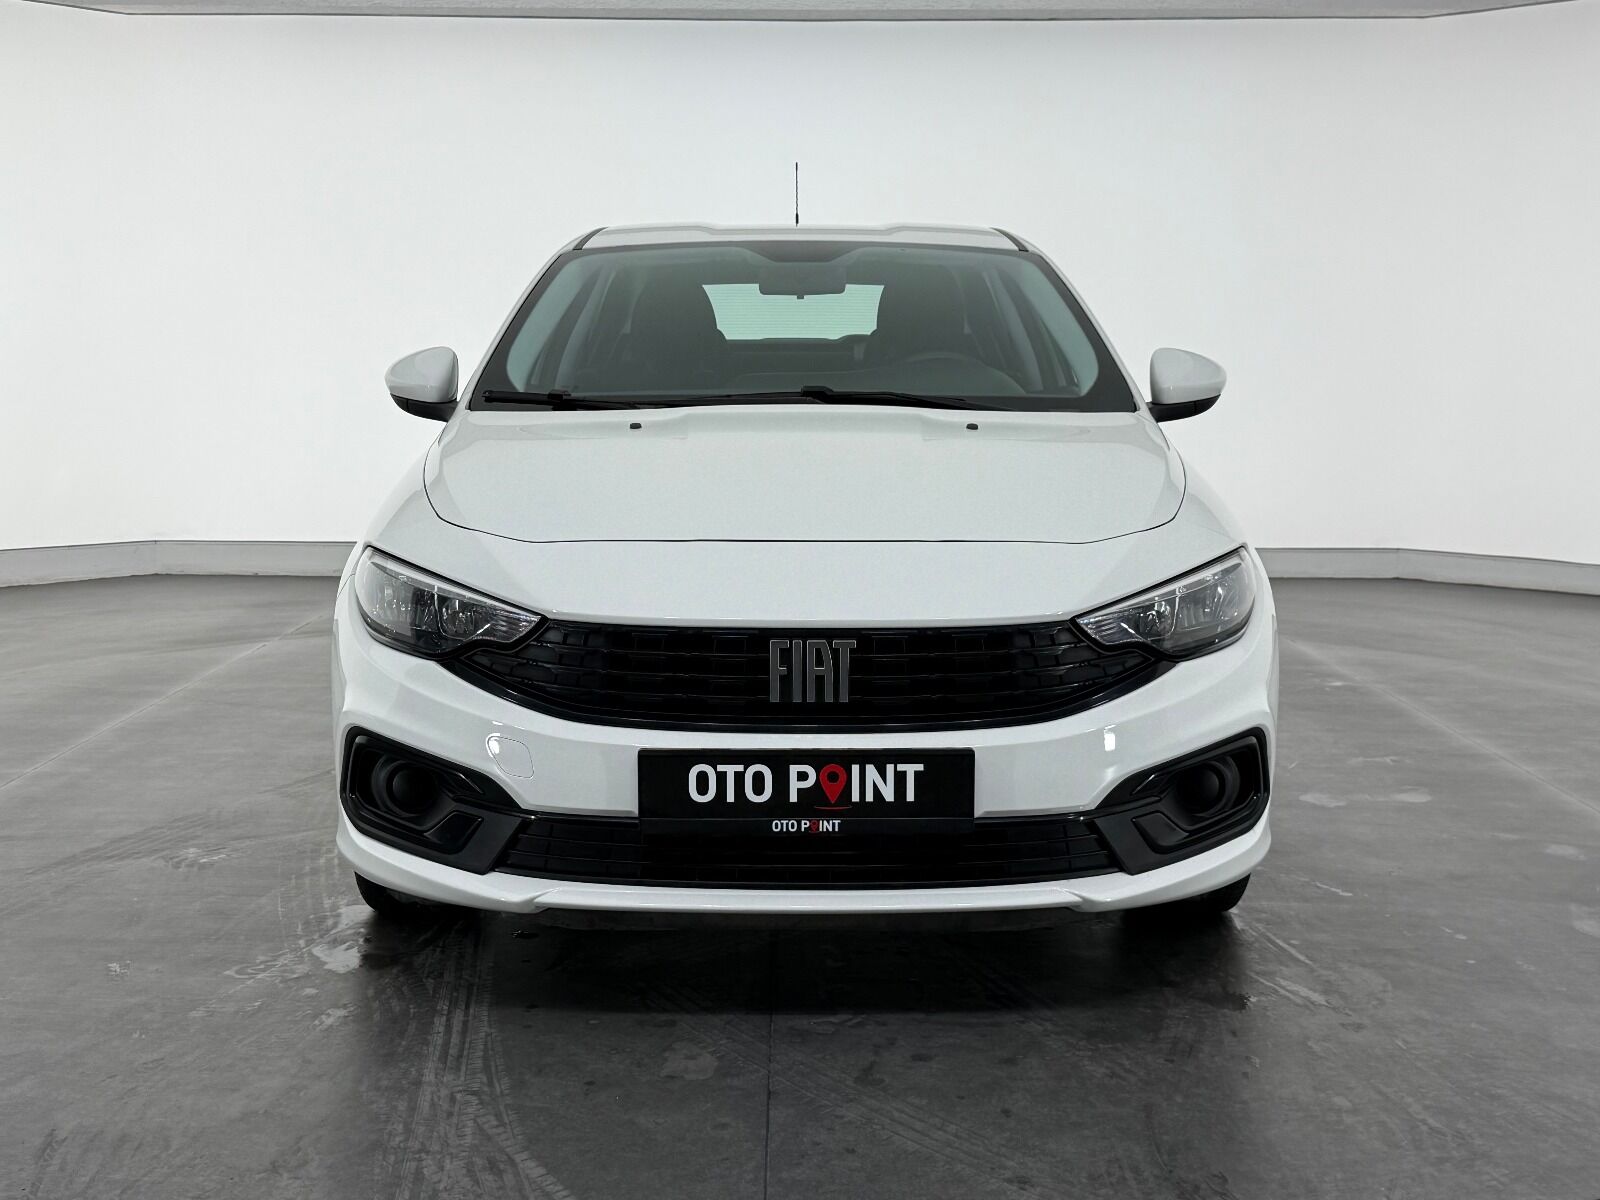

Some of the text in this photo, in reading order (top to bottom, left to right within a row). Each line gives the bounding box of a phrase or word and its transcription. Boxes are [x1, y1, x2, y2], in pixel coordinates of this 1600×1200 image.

[769, 639, 857, 703] FIAT
[688, 763, 924, 804] OTO POINT
[771, 819, 842, 833] OTO POINT
